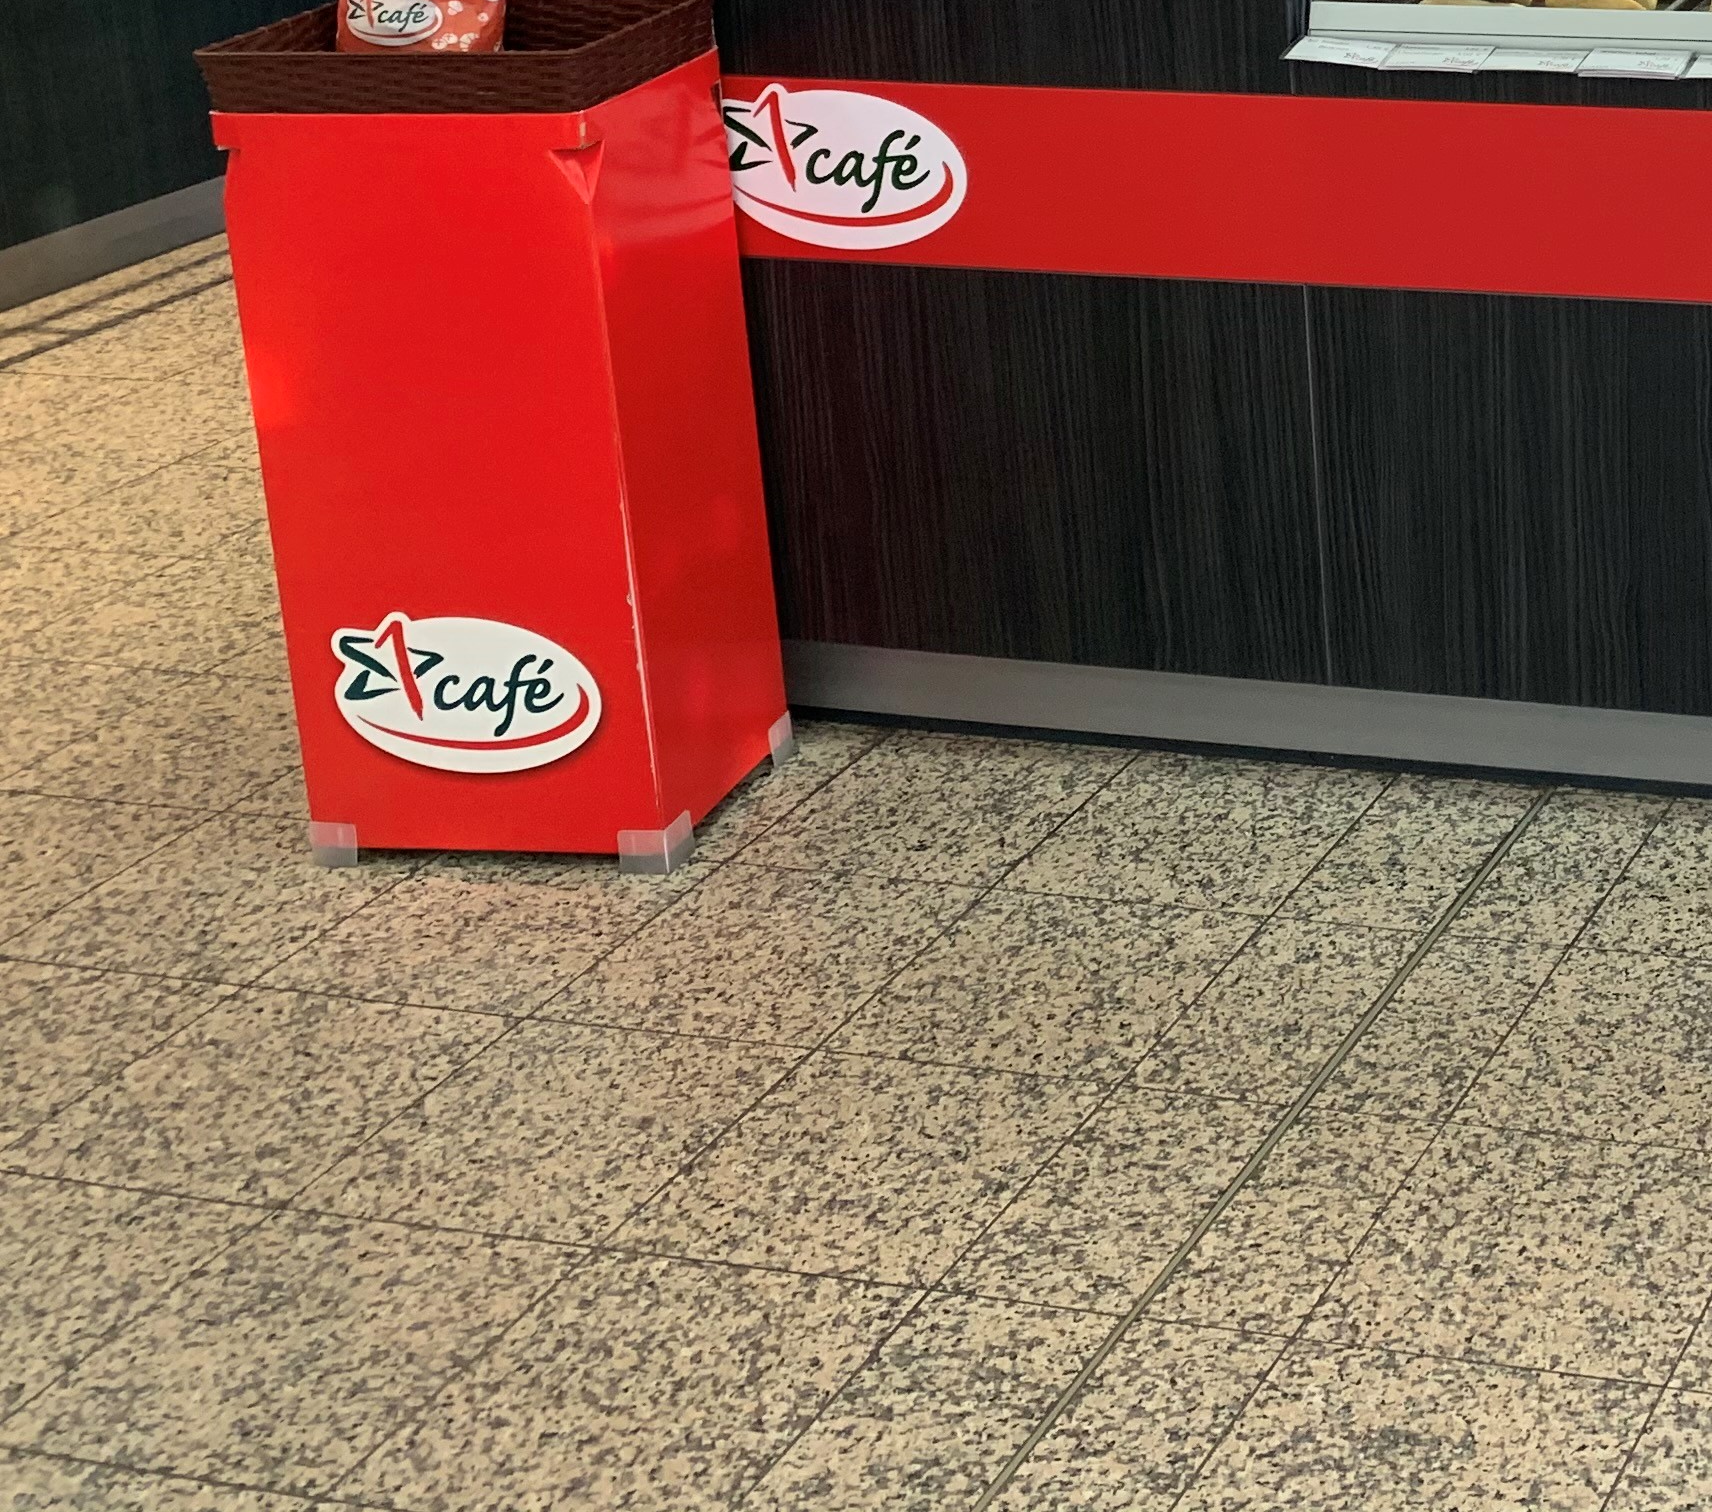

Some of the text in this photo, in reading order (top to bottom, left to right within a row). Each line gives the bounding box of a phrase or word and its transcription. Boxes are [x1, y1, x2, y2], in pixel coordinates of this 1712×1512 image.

[377, 2, 428, 34] café
[806, 130, 930, 213] café
[433, 654, 564, 737] café
